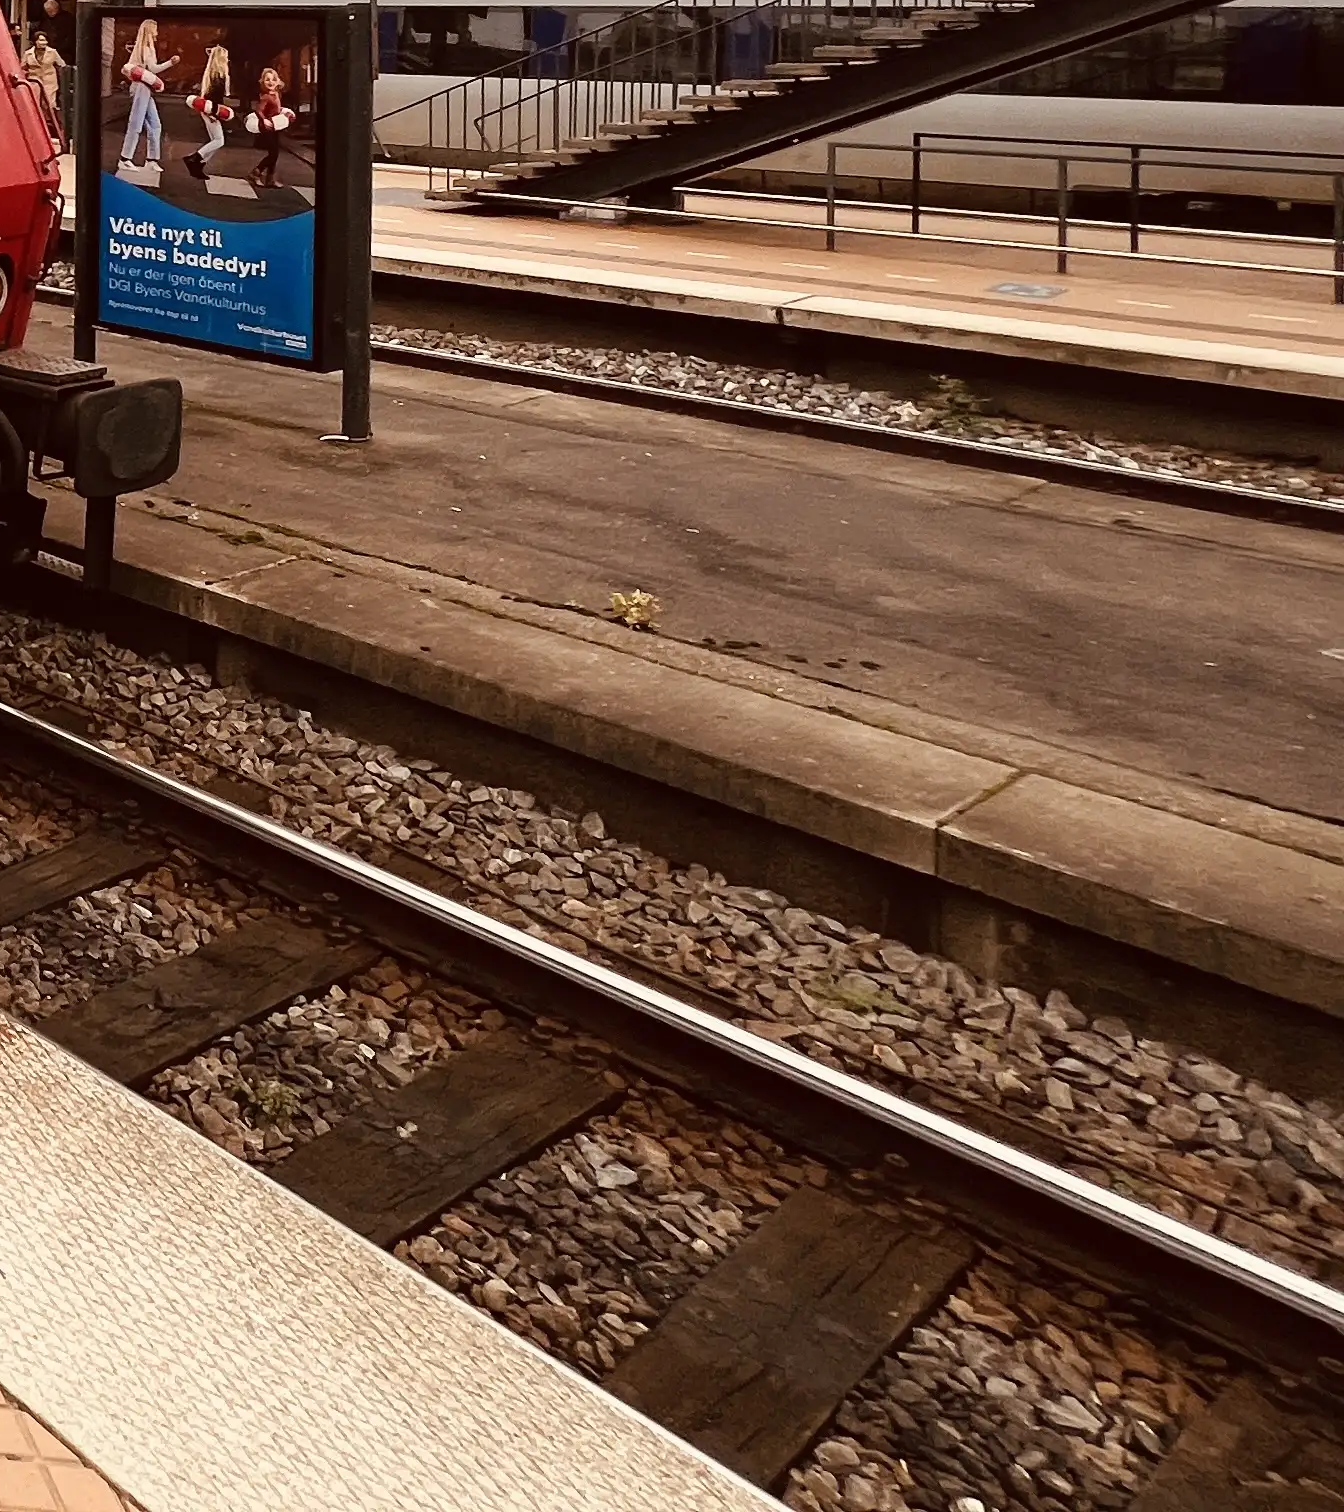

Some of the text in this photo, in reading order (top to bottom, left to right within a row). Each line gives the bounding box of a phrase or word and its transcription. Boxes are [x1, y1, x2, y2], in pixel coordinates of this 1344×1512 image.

[109, 216, 222, 249] Vådt nyt til
[109, 238, 267, 277] byens badedyr!
[109, 261, 126, 275] Nu
[128, 267, 142, 277] er
[144, 268, 165, 281] der
[168, 272, 195, 286] igen
[239, 281, 243, 294] i
[109, 277, 267, 316] DGI Byens Vandkulturhus
